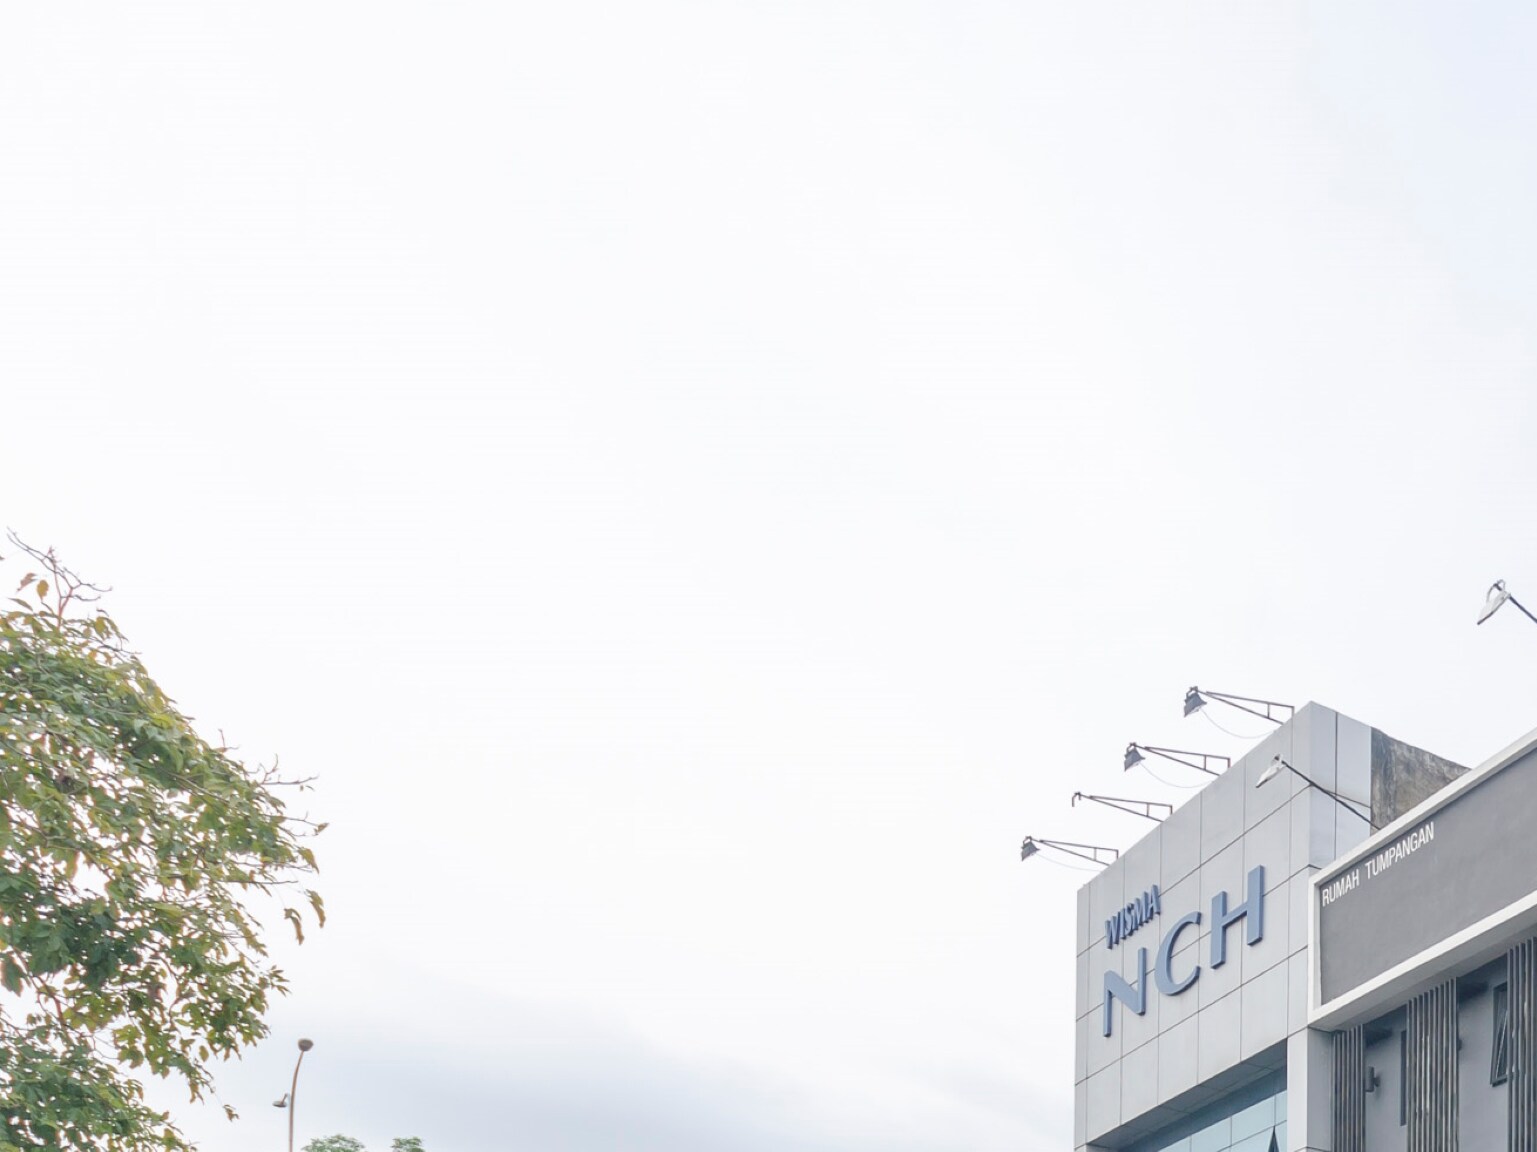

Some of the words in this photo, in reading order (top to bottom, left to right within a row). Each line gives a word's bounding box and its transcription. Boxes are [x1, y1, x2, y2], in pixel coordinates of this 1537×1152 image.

[1322, 868, 1360, 907] RUMAH
[1364, 821, 1435, 880] TUMPANGAN
[1103, 865, 1265, 1038] NCH
[1105, 884, 1162, 950] WISMA
